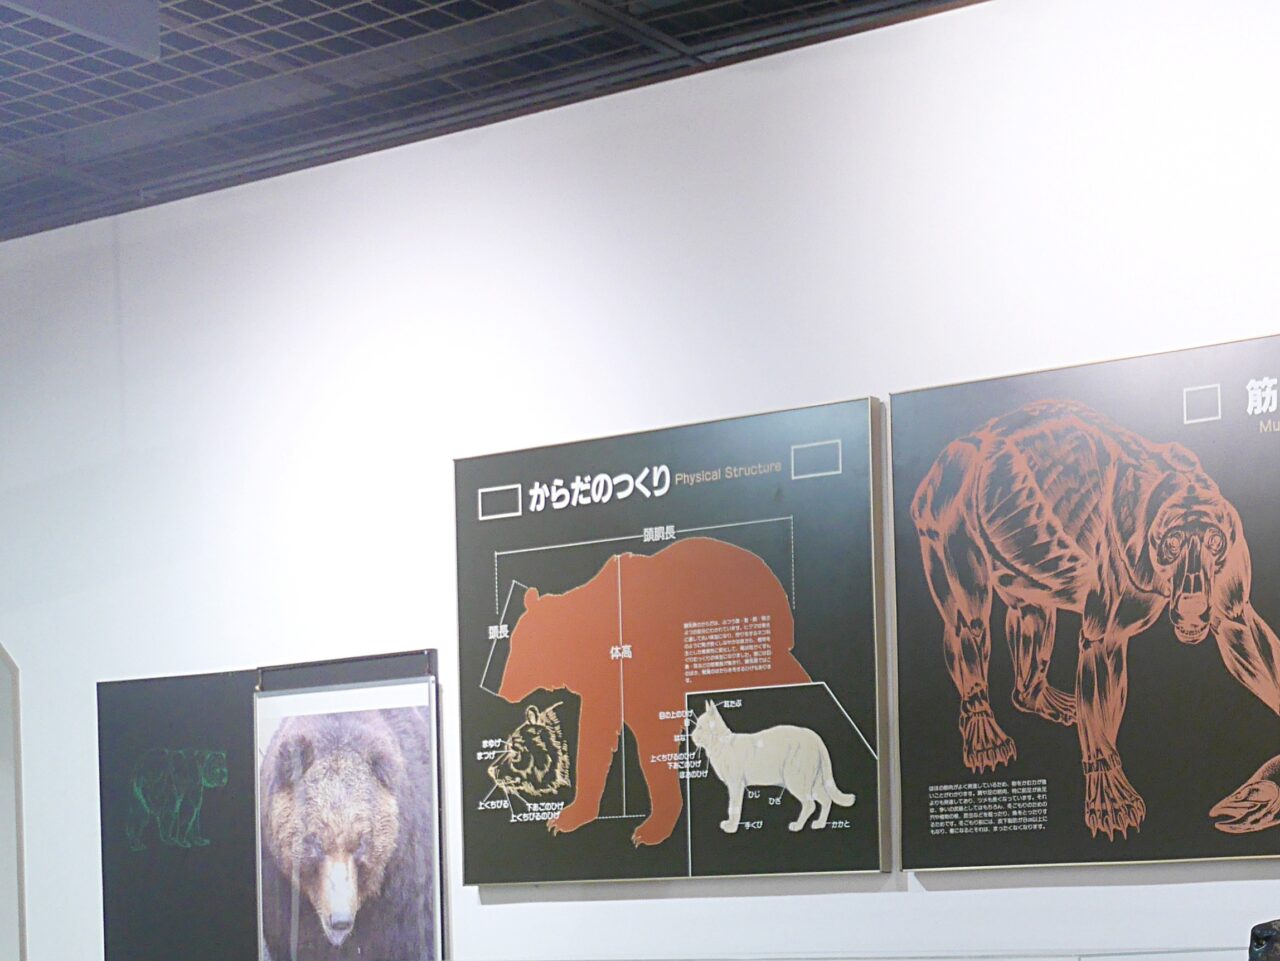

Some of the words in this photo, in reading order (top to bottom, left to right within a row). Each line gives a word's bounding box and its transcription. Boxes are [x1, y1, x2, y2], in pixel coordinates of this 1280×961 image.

[674, 467, 722, 486] Physical
[725, 460, 782, 480] Structure
[528, 464, 670, 512] からだのつくり
[610, 645, 632, 660] 体高
